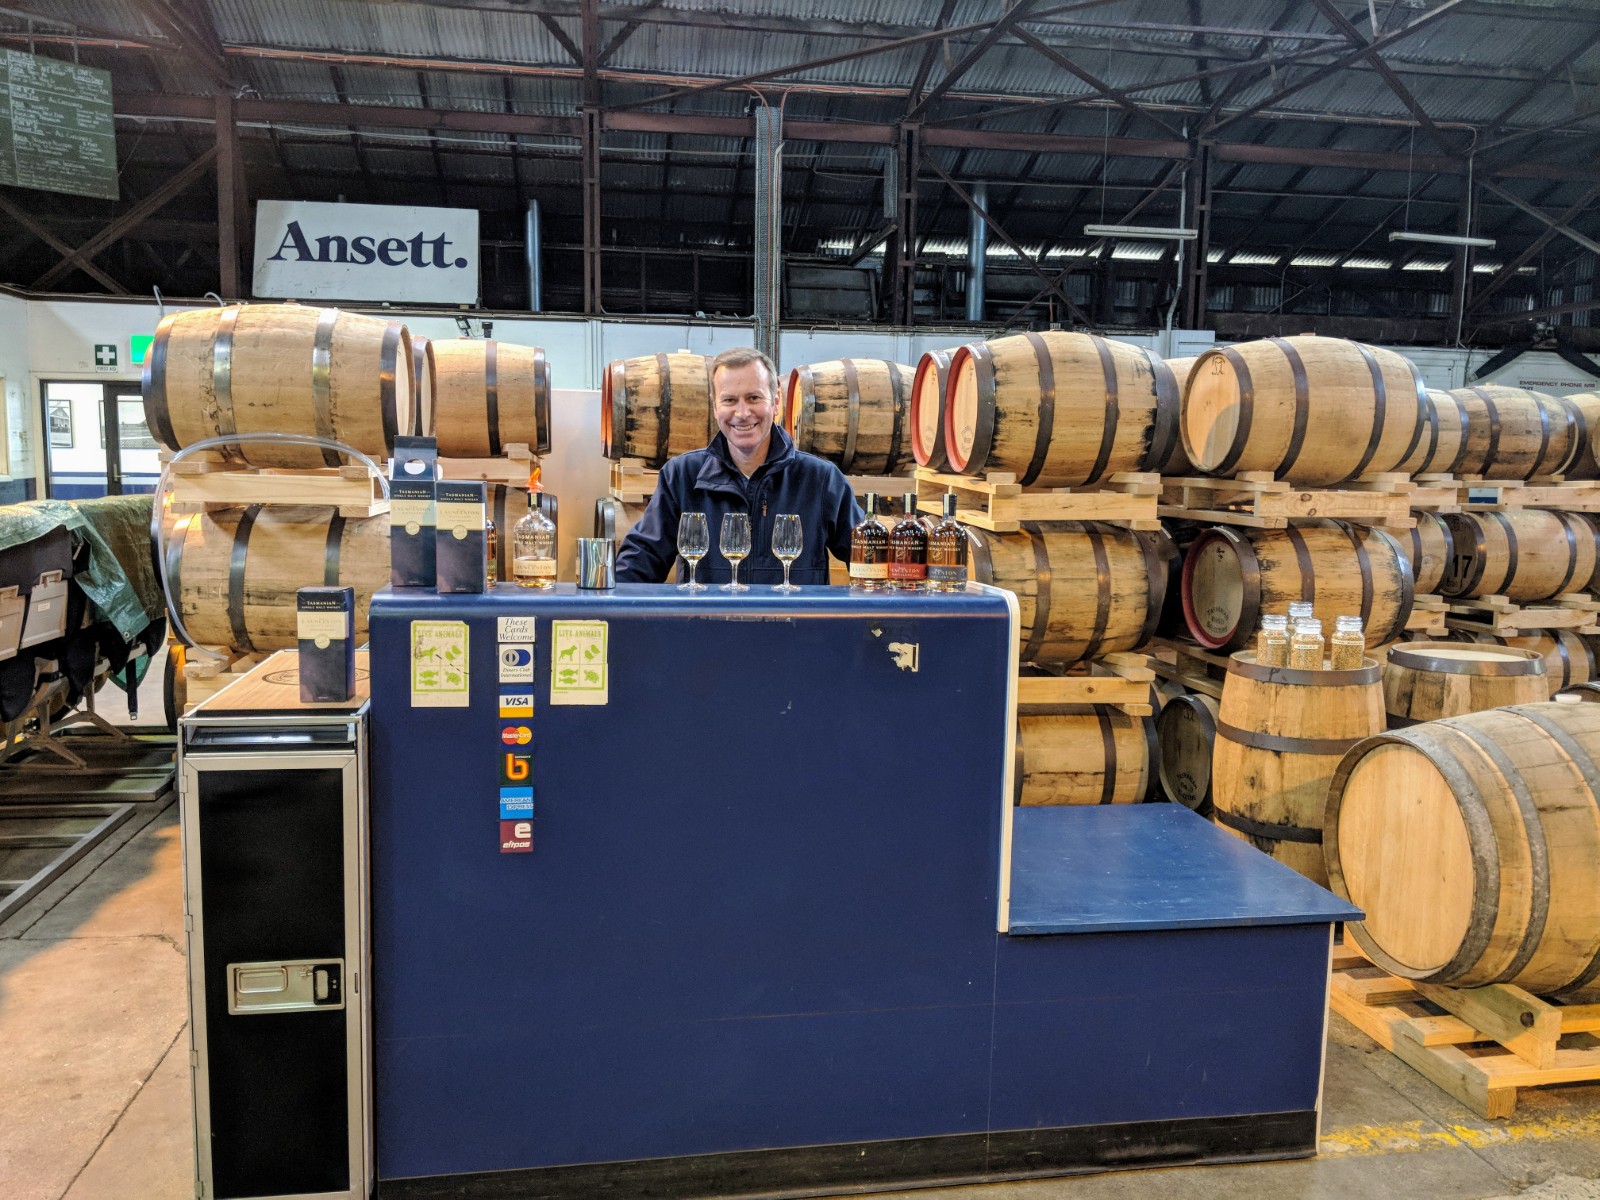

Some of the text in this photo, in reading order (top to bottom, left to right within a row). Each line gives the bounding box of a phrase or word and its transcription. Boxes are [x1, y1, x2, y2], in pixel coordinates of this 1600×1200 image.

[267, 220, 468, 268] Ansett.
[1453, 554, 1472, 578] 17
[418, 630, 433, 638] LIVE
[515, 823, 531, 838] e
[503, 840, 530, 848] eftpos
